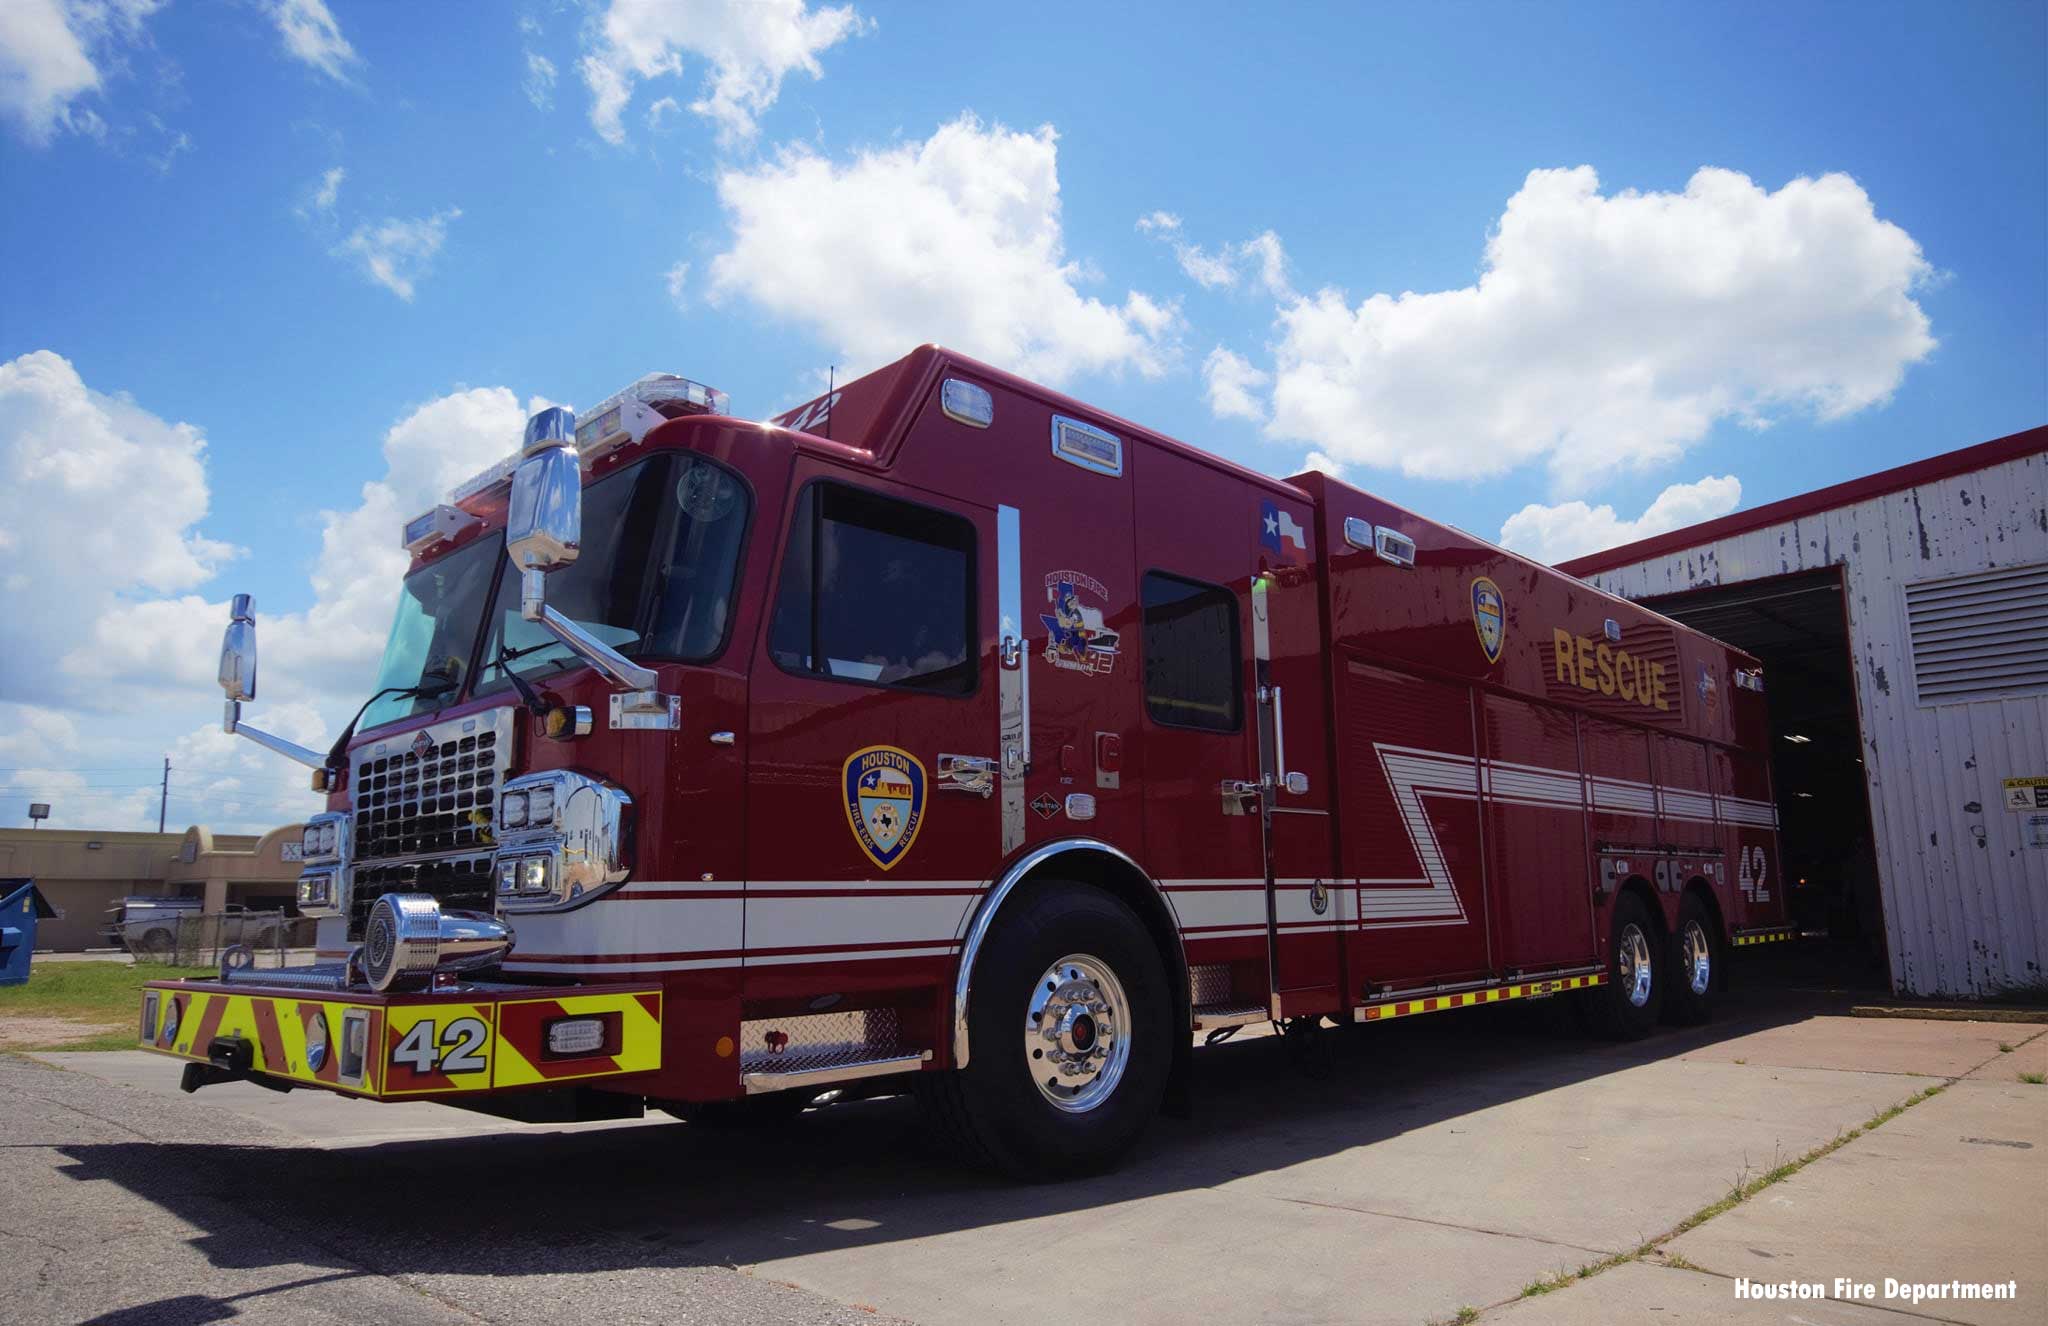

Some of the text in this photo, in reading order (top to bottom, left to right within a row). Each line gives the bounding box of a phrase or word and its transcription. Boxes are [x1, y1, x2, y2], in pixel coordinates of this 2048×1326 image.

[1045, 570, 1087, 588] HOUSTON
[1553, 627, 1669, 712] RESCUE
[861, 752, 910, 775] HOUSTON
[898, 810, 920, 848] RESCUE
[1738, 845, 1771, 903] 42
[392, 1017, 488, 1075] 42
